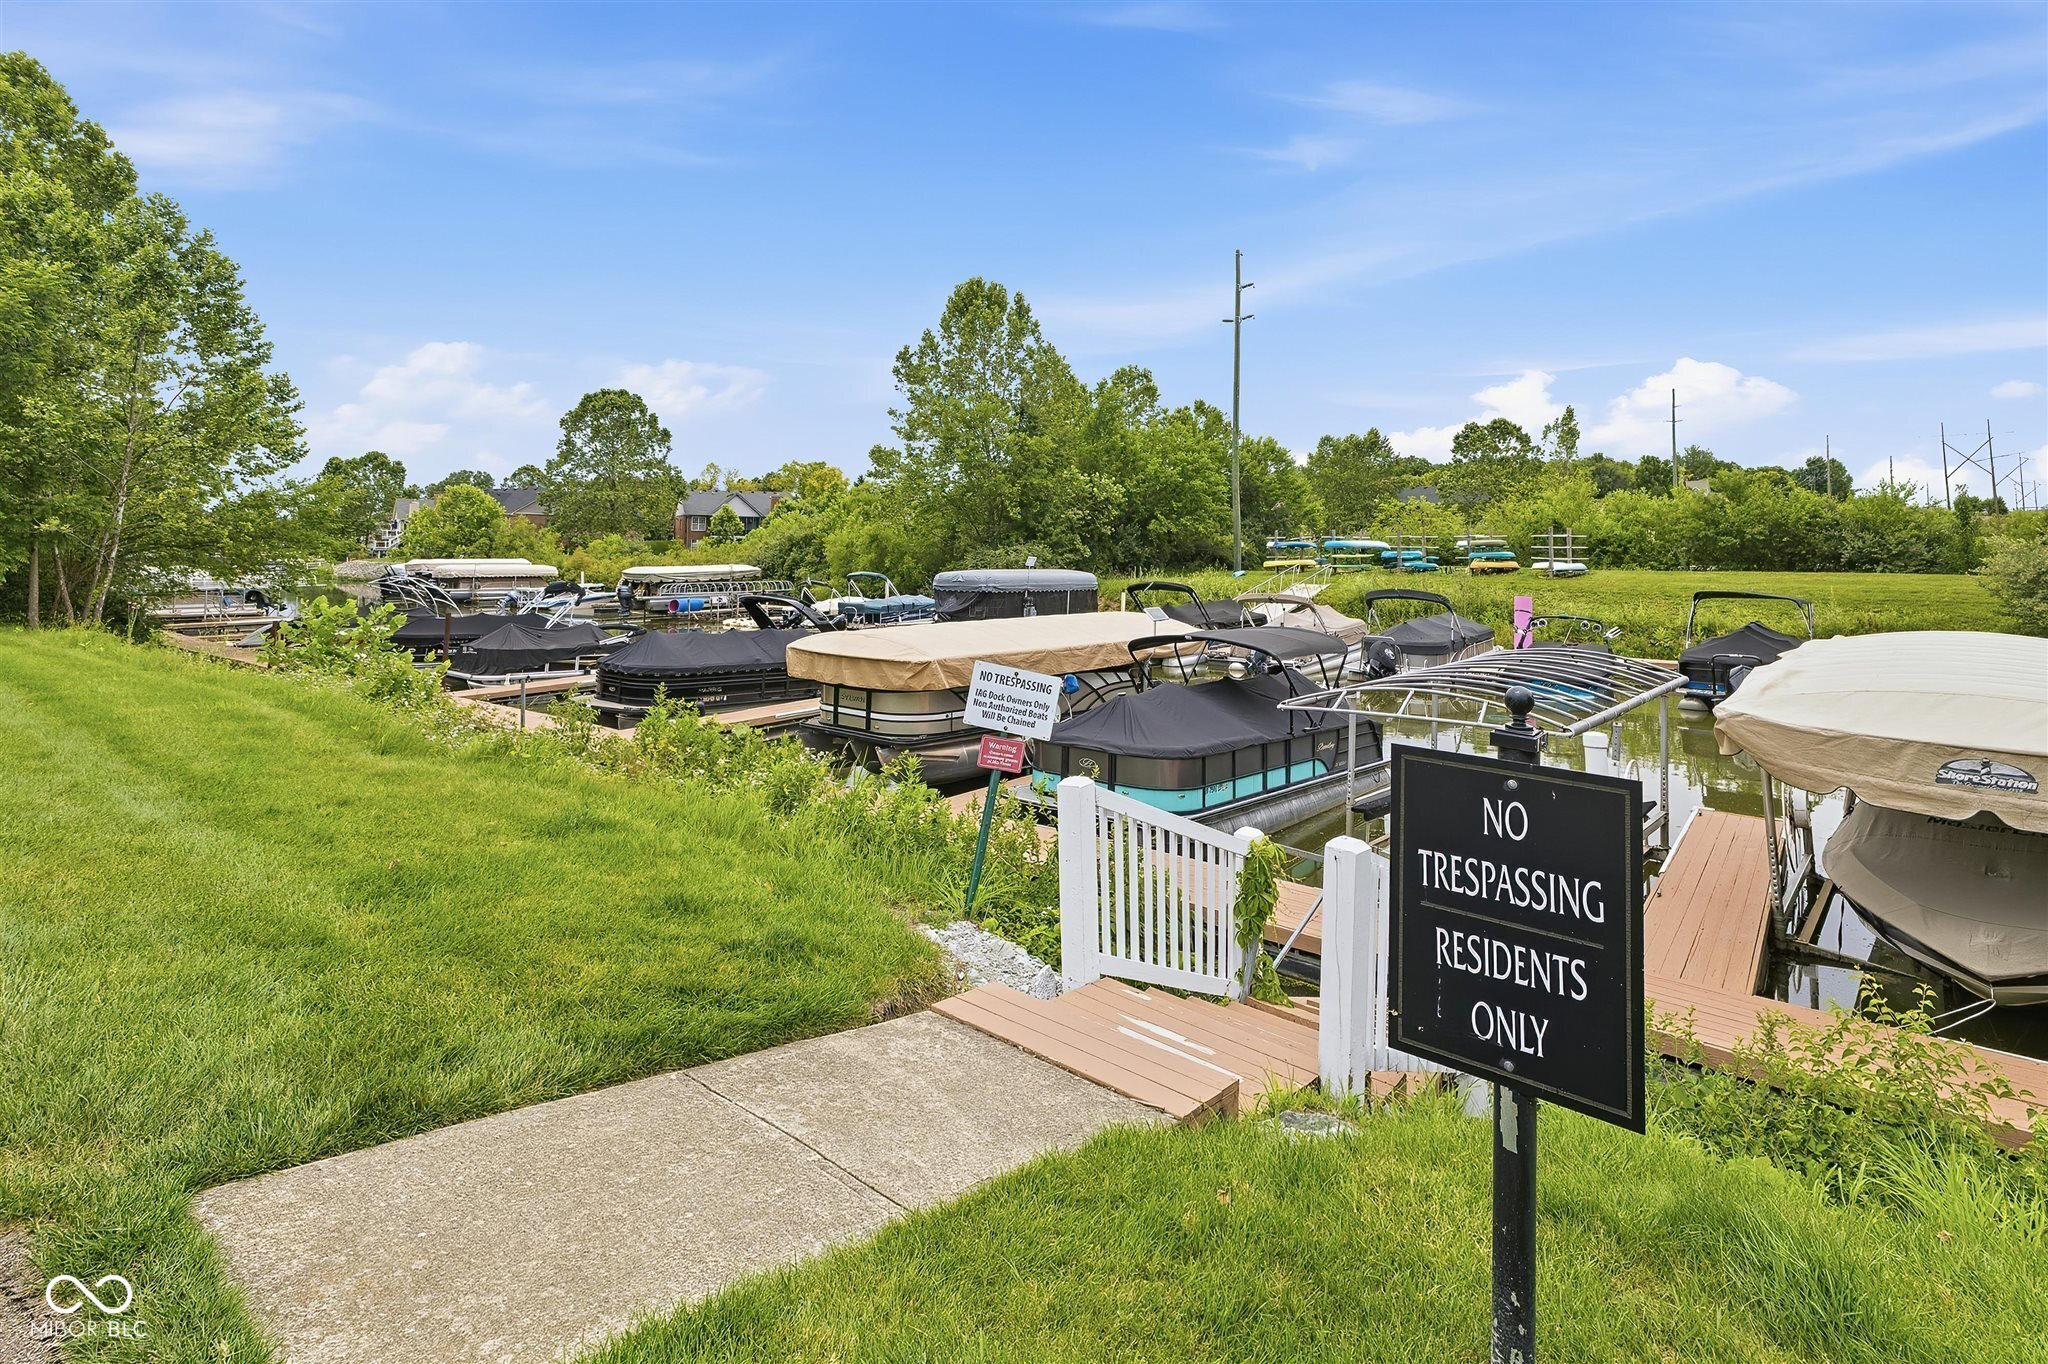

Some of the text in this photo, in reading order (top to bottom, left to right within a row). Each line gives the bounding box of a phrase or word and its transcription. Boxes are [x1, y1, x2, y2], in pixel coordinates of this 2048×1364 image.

[979, 670, 1053, 695] NO TRESPASSING
[972, 698, 1049, 721] Non Authorized Boats
[988, 691, 1006, 702] Dock
[1006, 695, 1033, 708] Owners
[1033, 700, 1051, 712] Only
[981, 709, 1036, 729] Will Be Chained
[988, 741, 1017, 754] Warning
[1482, 797, 1528, 841] NO
[1417, 848, 1605, 923] TRESPASSING
[1435, 926, 1588, 1001] RESIDENTS
[1471, 1000, 1549, 1058] ONLY
